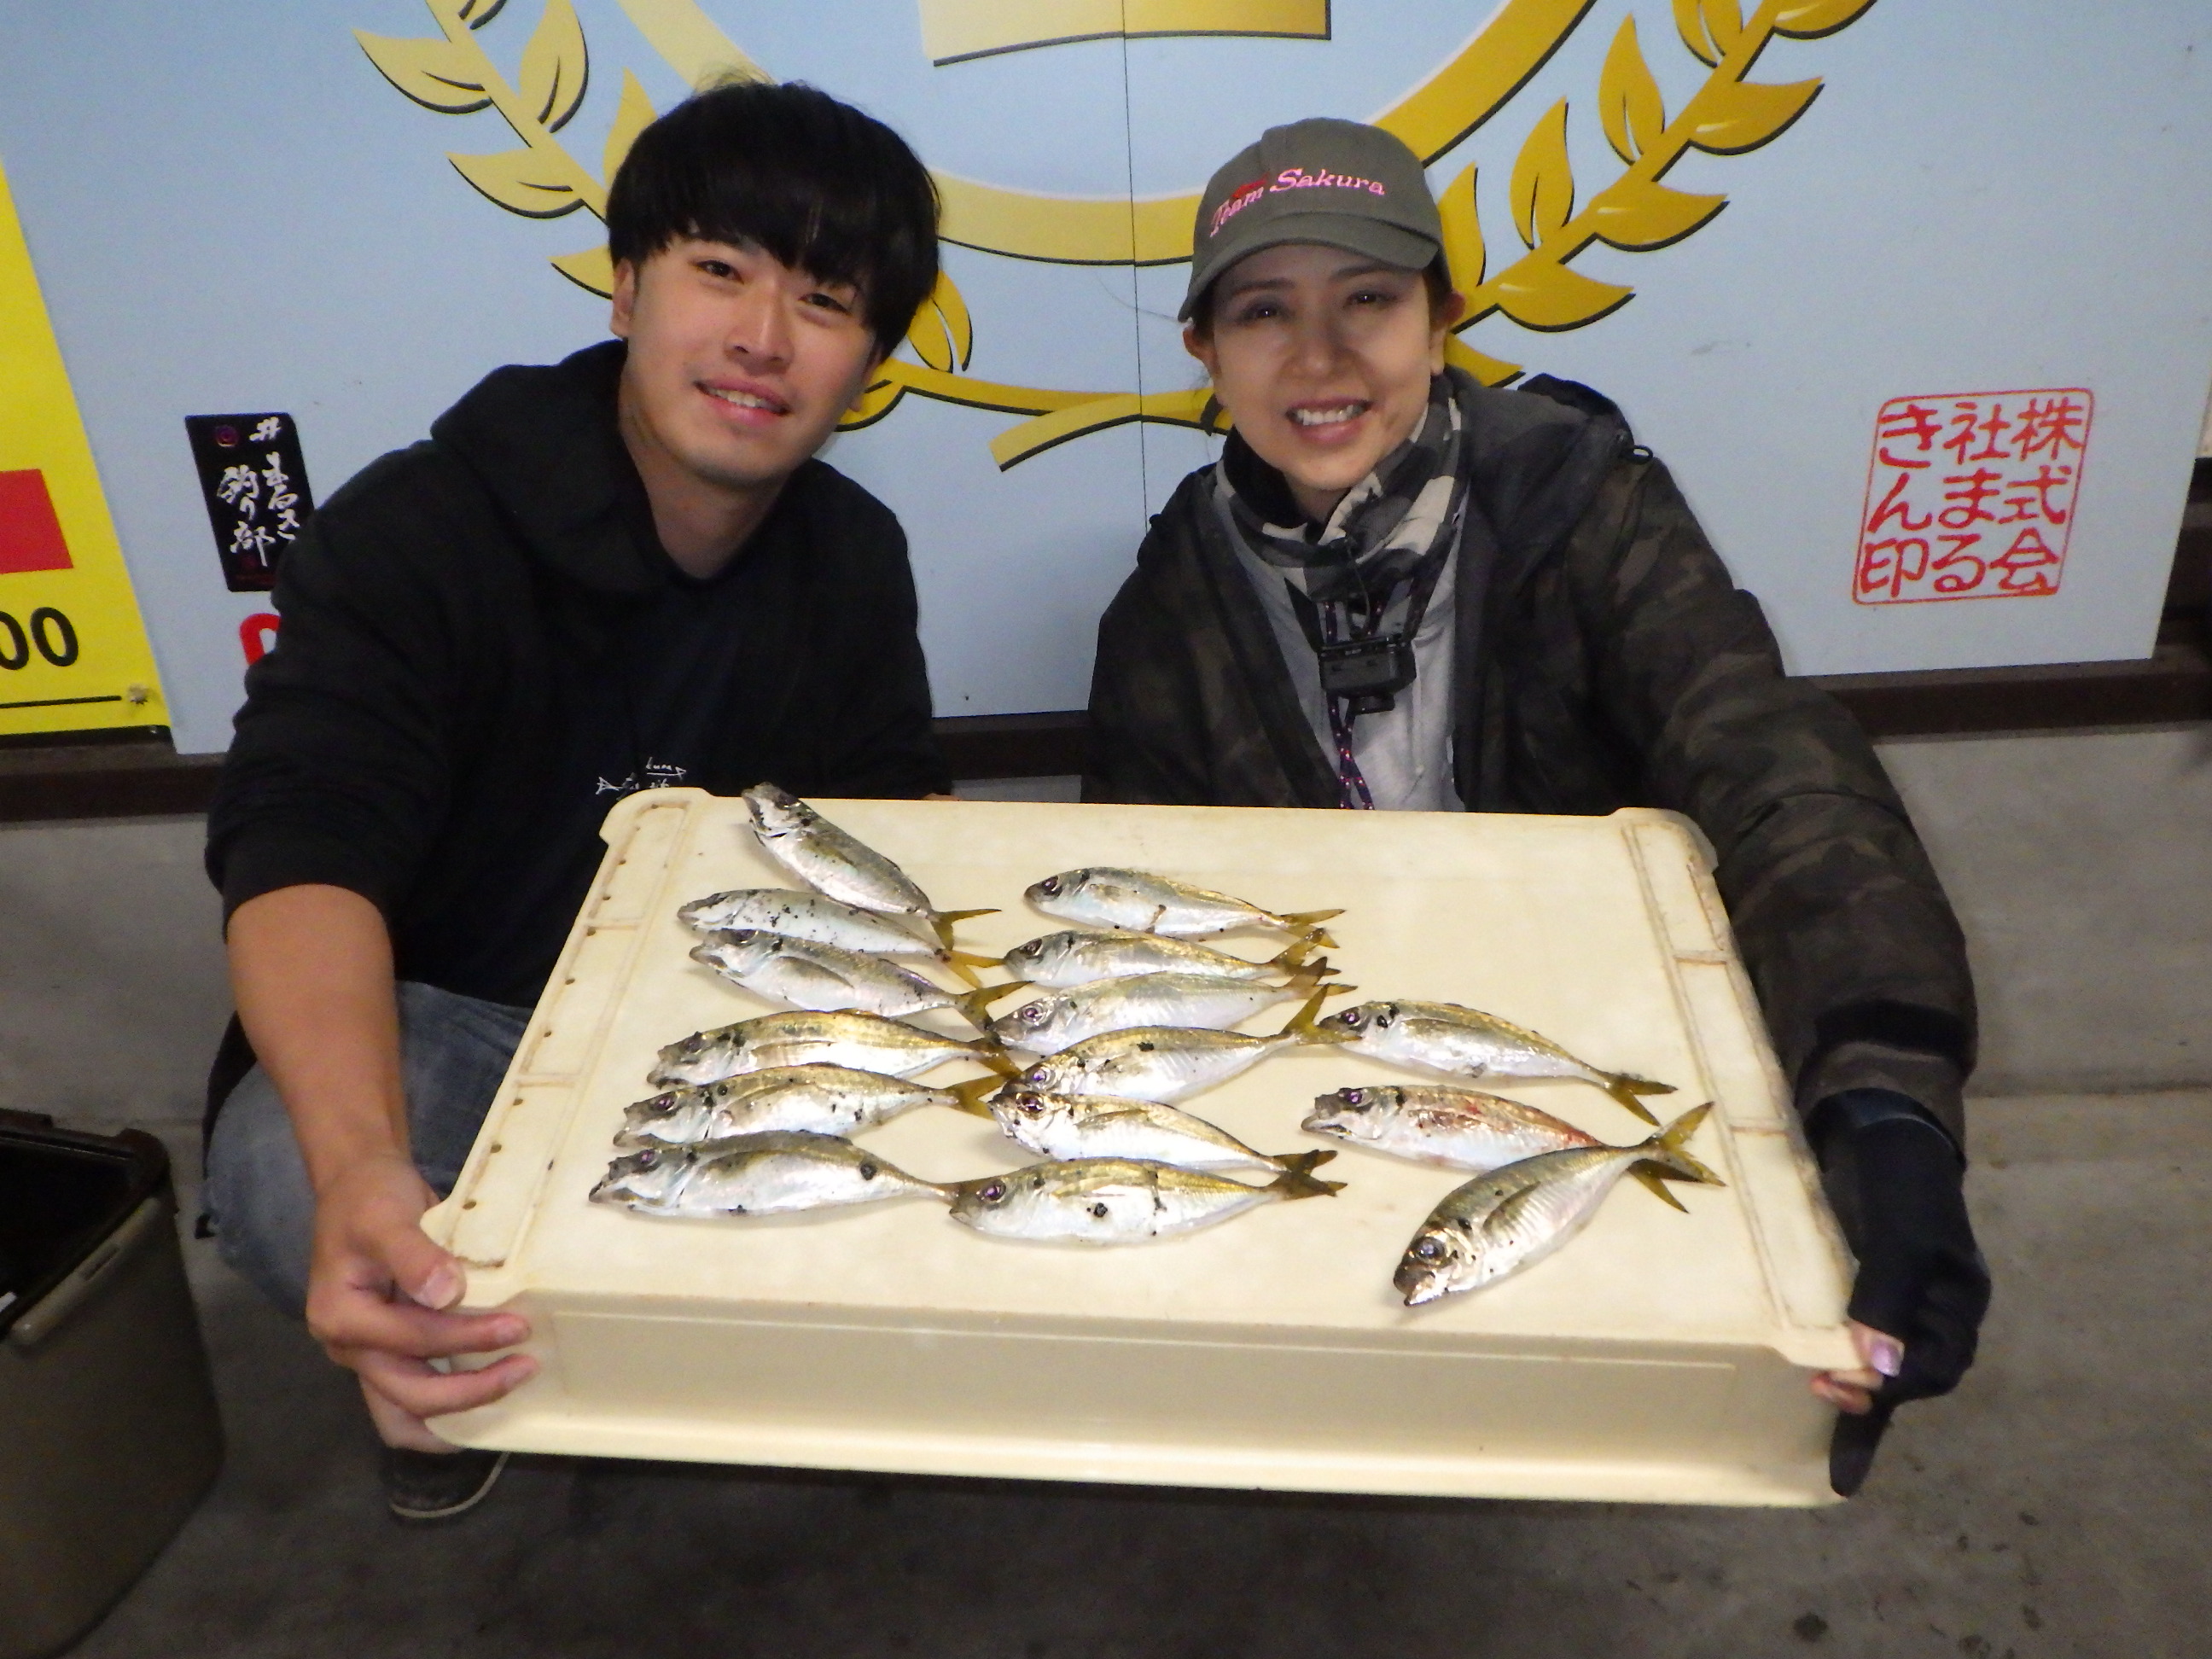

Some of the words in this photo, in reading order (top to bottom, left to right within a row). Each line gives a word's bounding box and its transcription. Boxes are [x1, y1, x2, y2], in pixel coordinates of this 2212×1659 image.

[1269, 167, 1386, 196] Sakura
[216, 463, 276, 568] 釣り部
[1859, 403, 1943, 598] きん印
[1930, 401, 2011, 593] 社まる
[1988, 397, 2084, 597] 株式会
